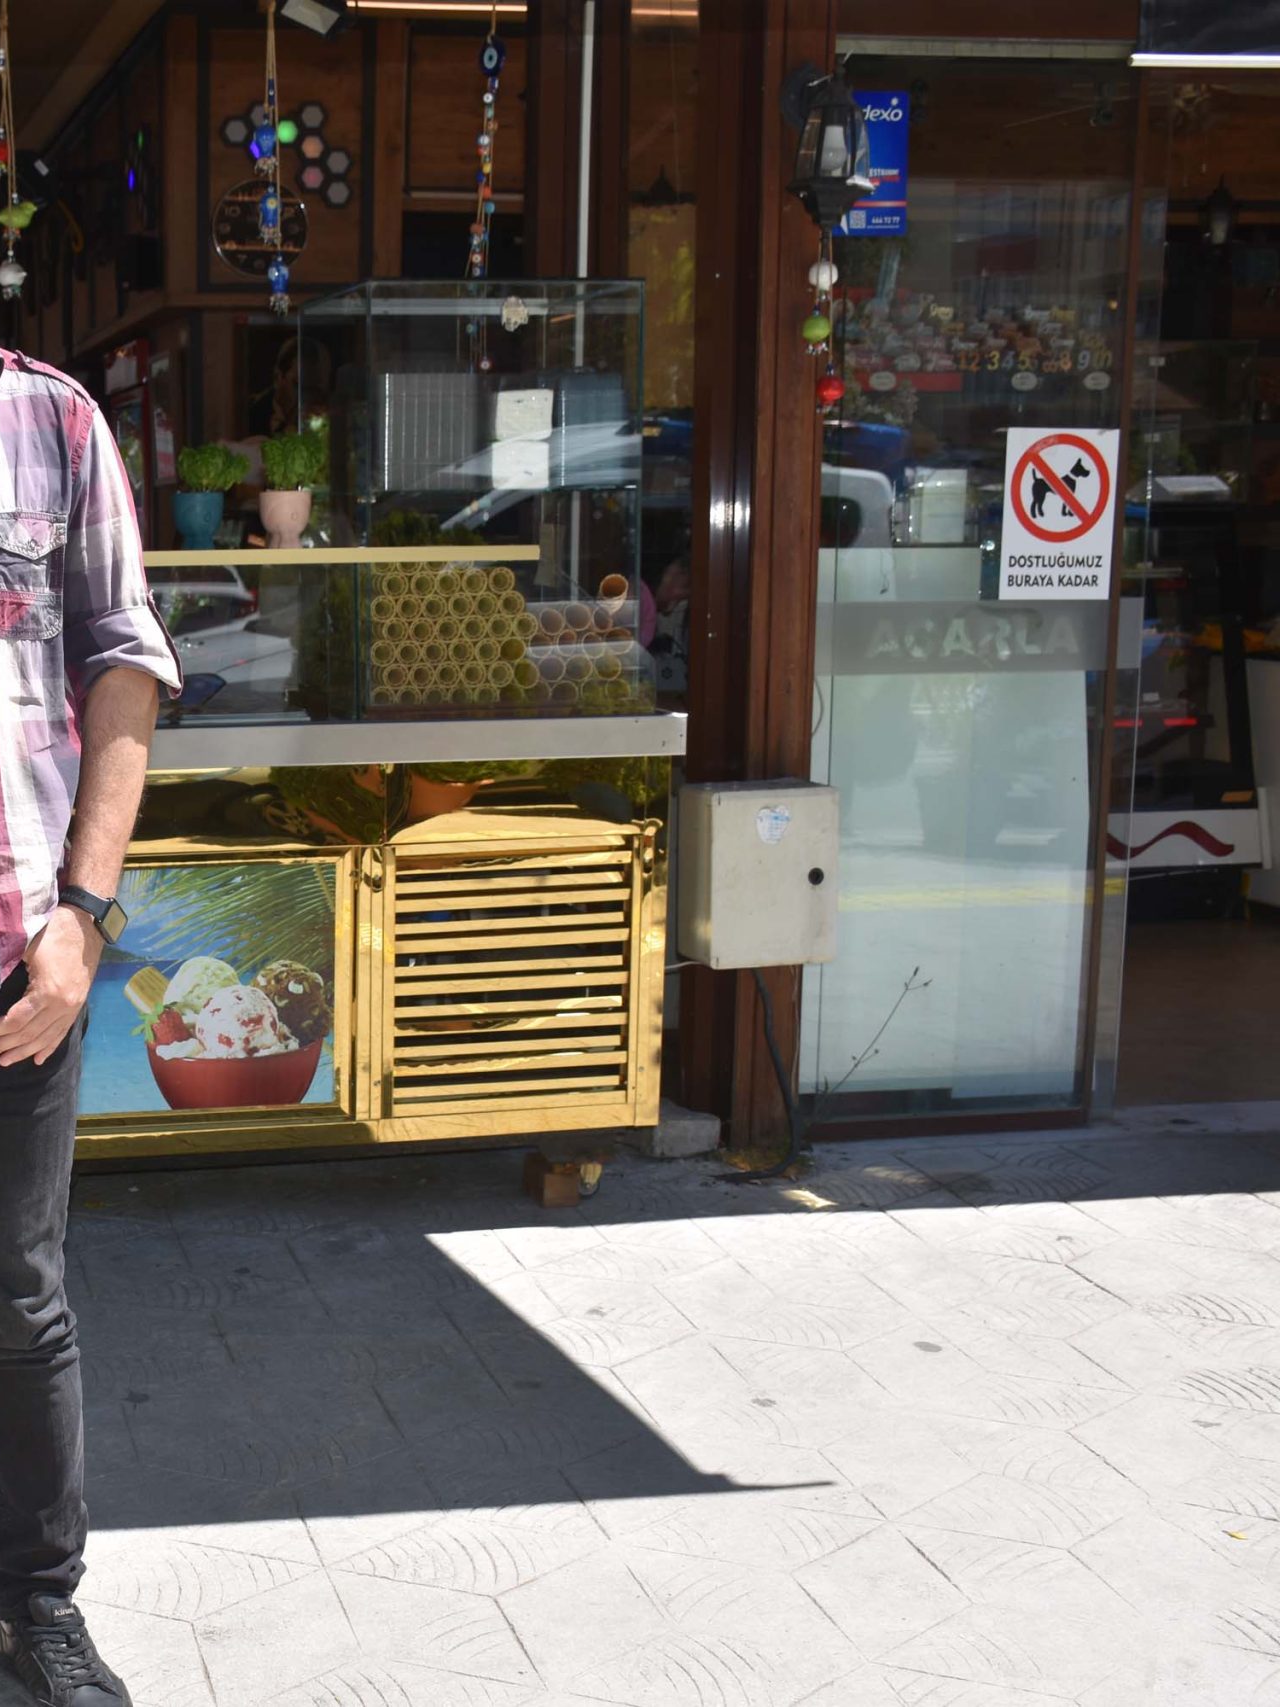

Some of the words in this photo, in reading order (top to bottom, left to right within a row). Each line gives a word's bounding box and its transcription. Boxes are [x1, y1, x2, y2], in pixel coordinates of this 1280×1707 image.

[862, 104, 903, 121] dexo
[1008, 552, 1103, 568] DOSTLUĞUMUZ
[1007, 575, 1054, 587] BURAYA
[1057, 575, 1099, 587] KADAR
